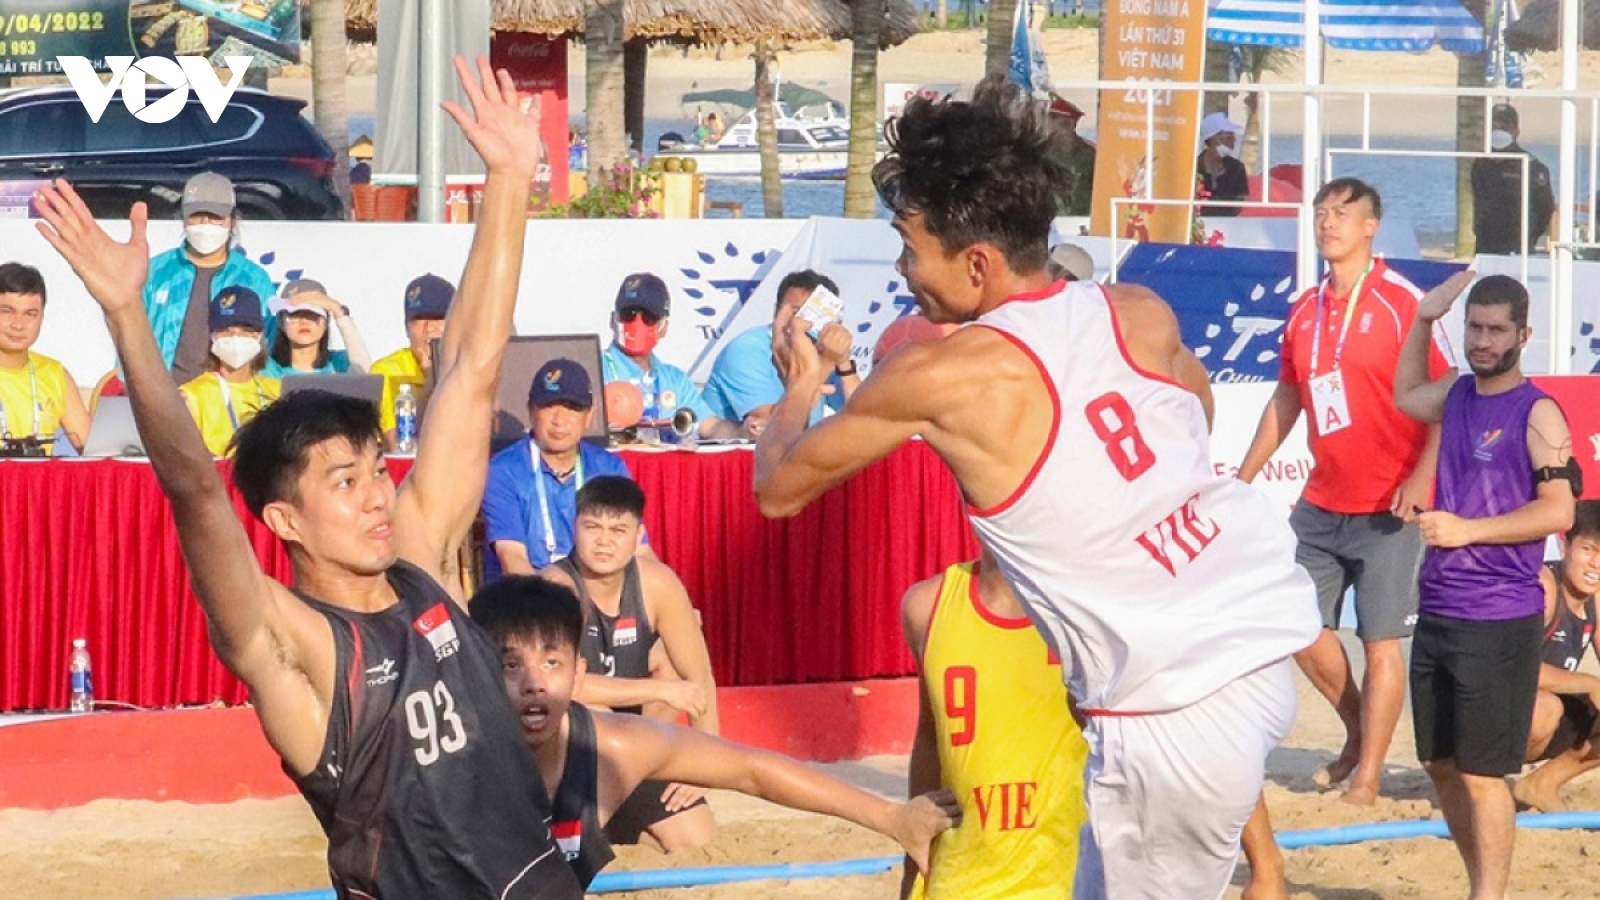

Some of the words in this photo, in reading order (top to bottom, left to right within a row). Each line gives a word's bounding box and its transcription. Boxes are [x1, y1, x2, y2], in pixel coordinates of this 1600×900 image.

[1123, 75, 1173, 106] 2021
[1150, 51, 1184, 70] NAM
[1085, 391, 1157, 483] 8
[1325, 404, 1342, 430] A
[1134, 492, 1221, 578] VIE
[404, 679, 467, 766] 93
[944, 665, 976, 747] 9
[973, 781, 1037, 832] VIE
